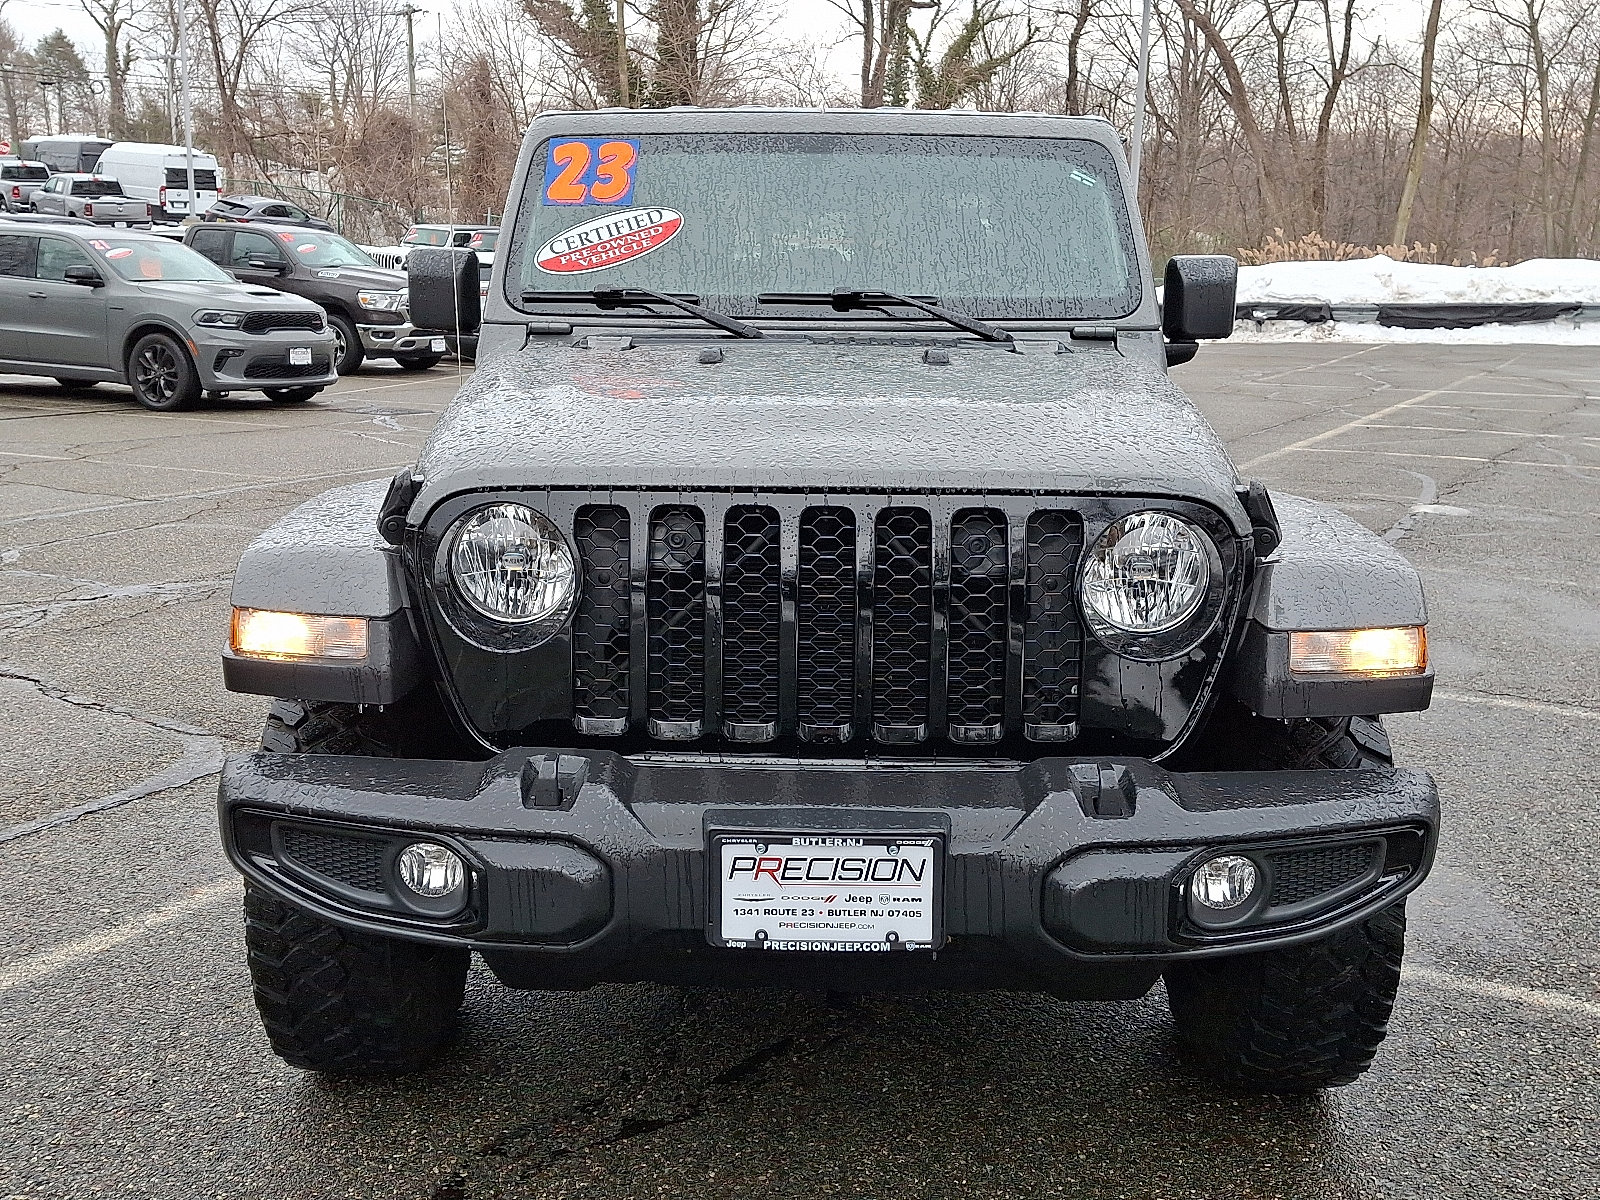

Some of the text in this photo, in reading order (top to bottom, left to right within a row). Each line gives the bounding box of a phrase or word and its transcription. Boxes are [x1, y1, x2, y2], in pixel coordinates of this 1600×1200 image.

[547, 142, 638, 204] 23
[549, 209, 664, 254] CERTIFIED
[560, 226, 663, 265] PRE-OWNED
[578, 239, 653, 266] VEHICLE
[728, 856, 927, 882] PRECISION
[844, 893, 873, 904] Jeep
[733, 908, 922, 918] 1341 ROUTE 23 BUTLER NJ 07405
[778, 921, 875, 930] PRECISIONJEEP.COM
[726, 940, 747, 949] Jeep
[763, 941, 891, 951] PRECISIONJEEP.COM
